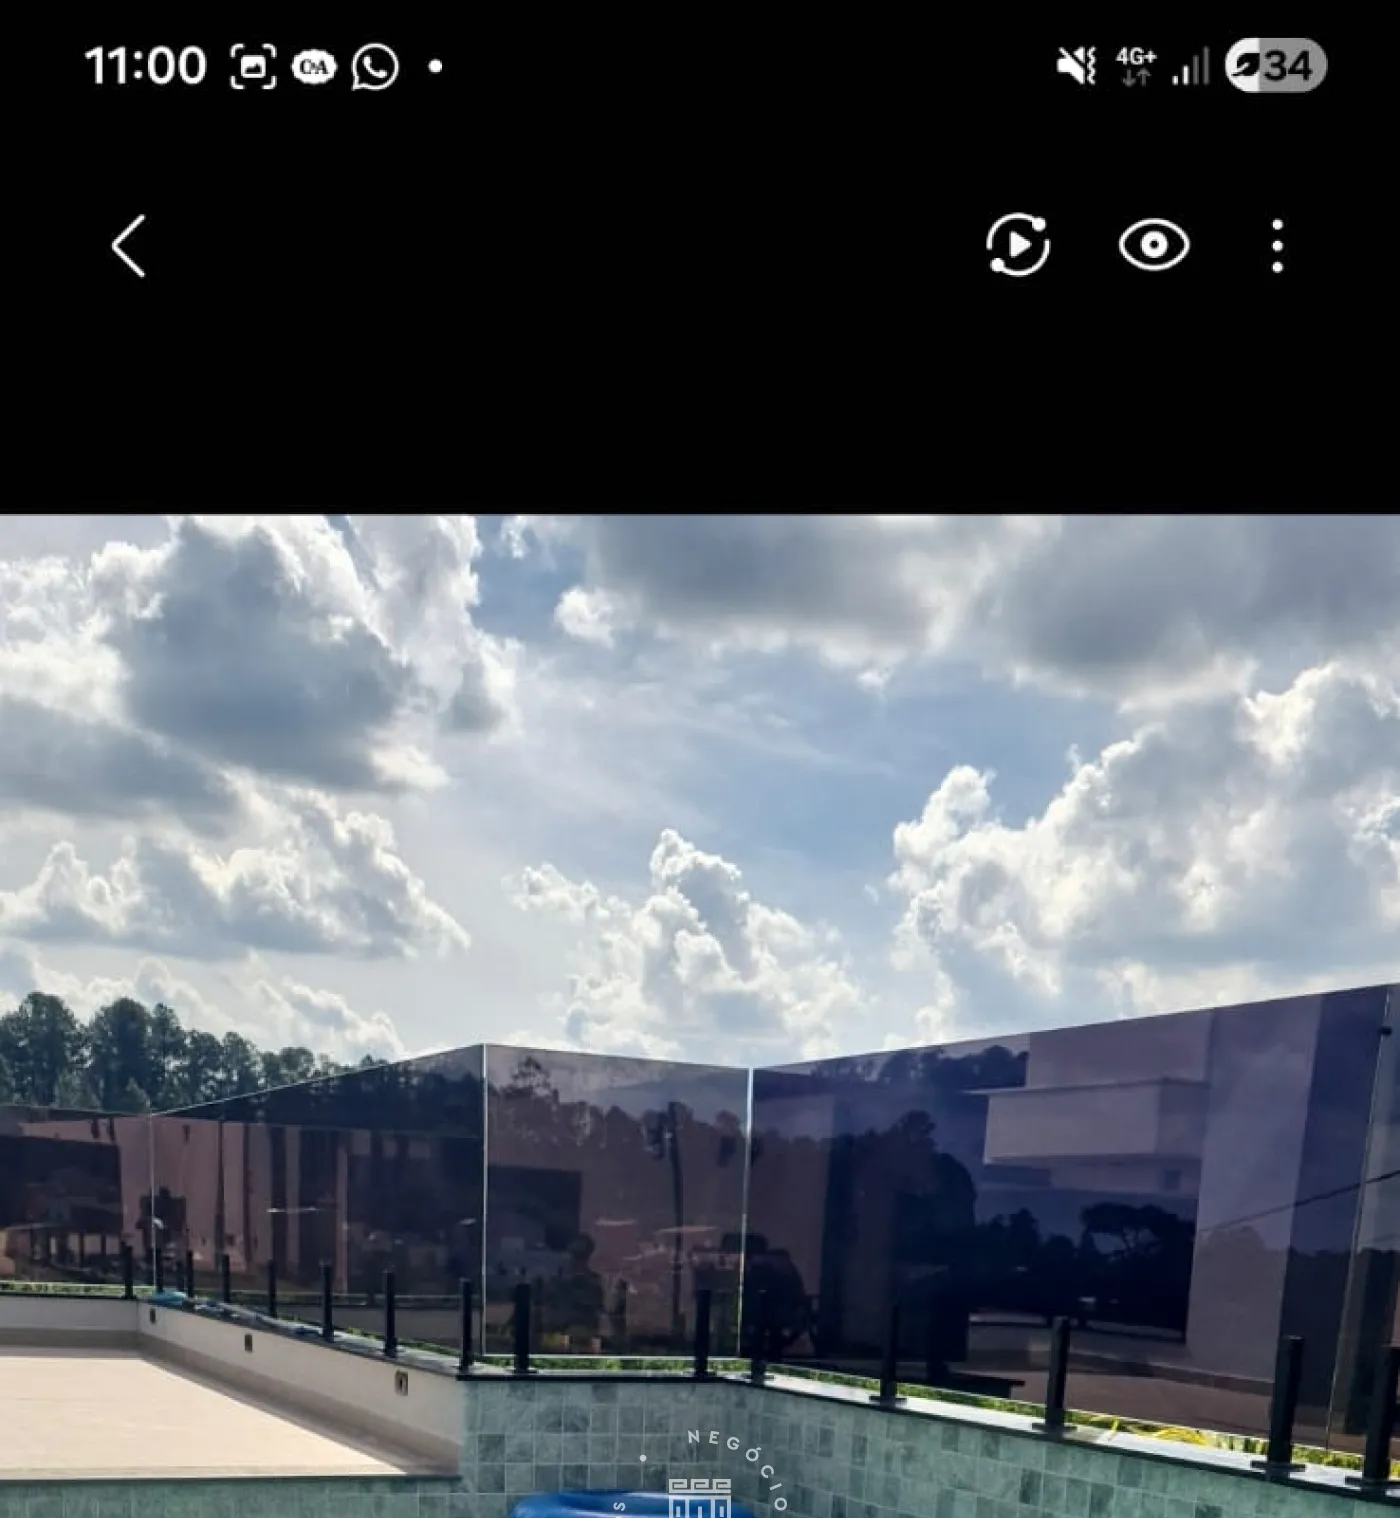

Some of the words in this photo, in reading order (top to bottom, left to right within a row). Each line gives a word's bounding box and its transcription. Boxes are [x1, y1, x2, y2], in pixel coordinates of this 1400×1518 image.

[84, 45, 207, 85] 11:00
[1115, 46, 1157, 66] 4G+
[1263, 49, 1313, 82] 34
